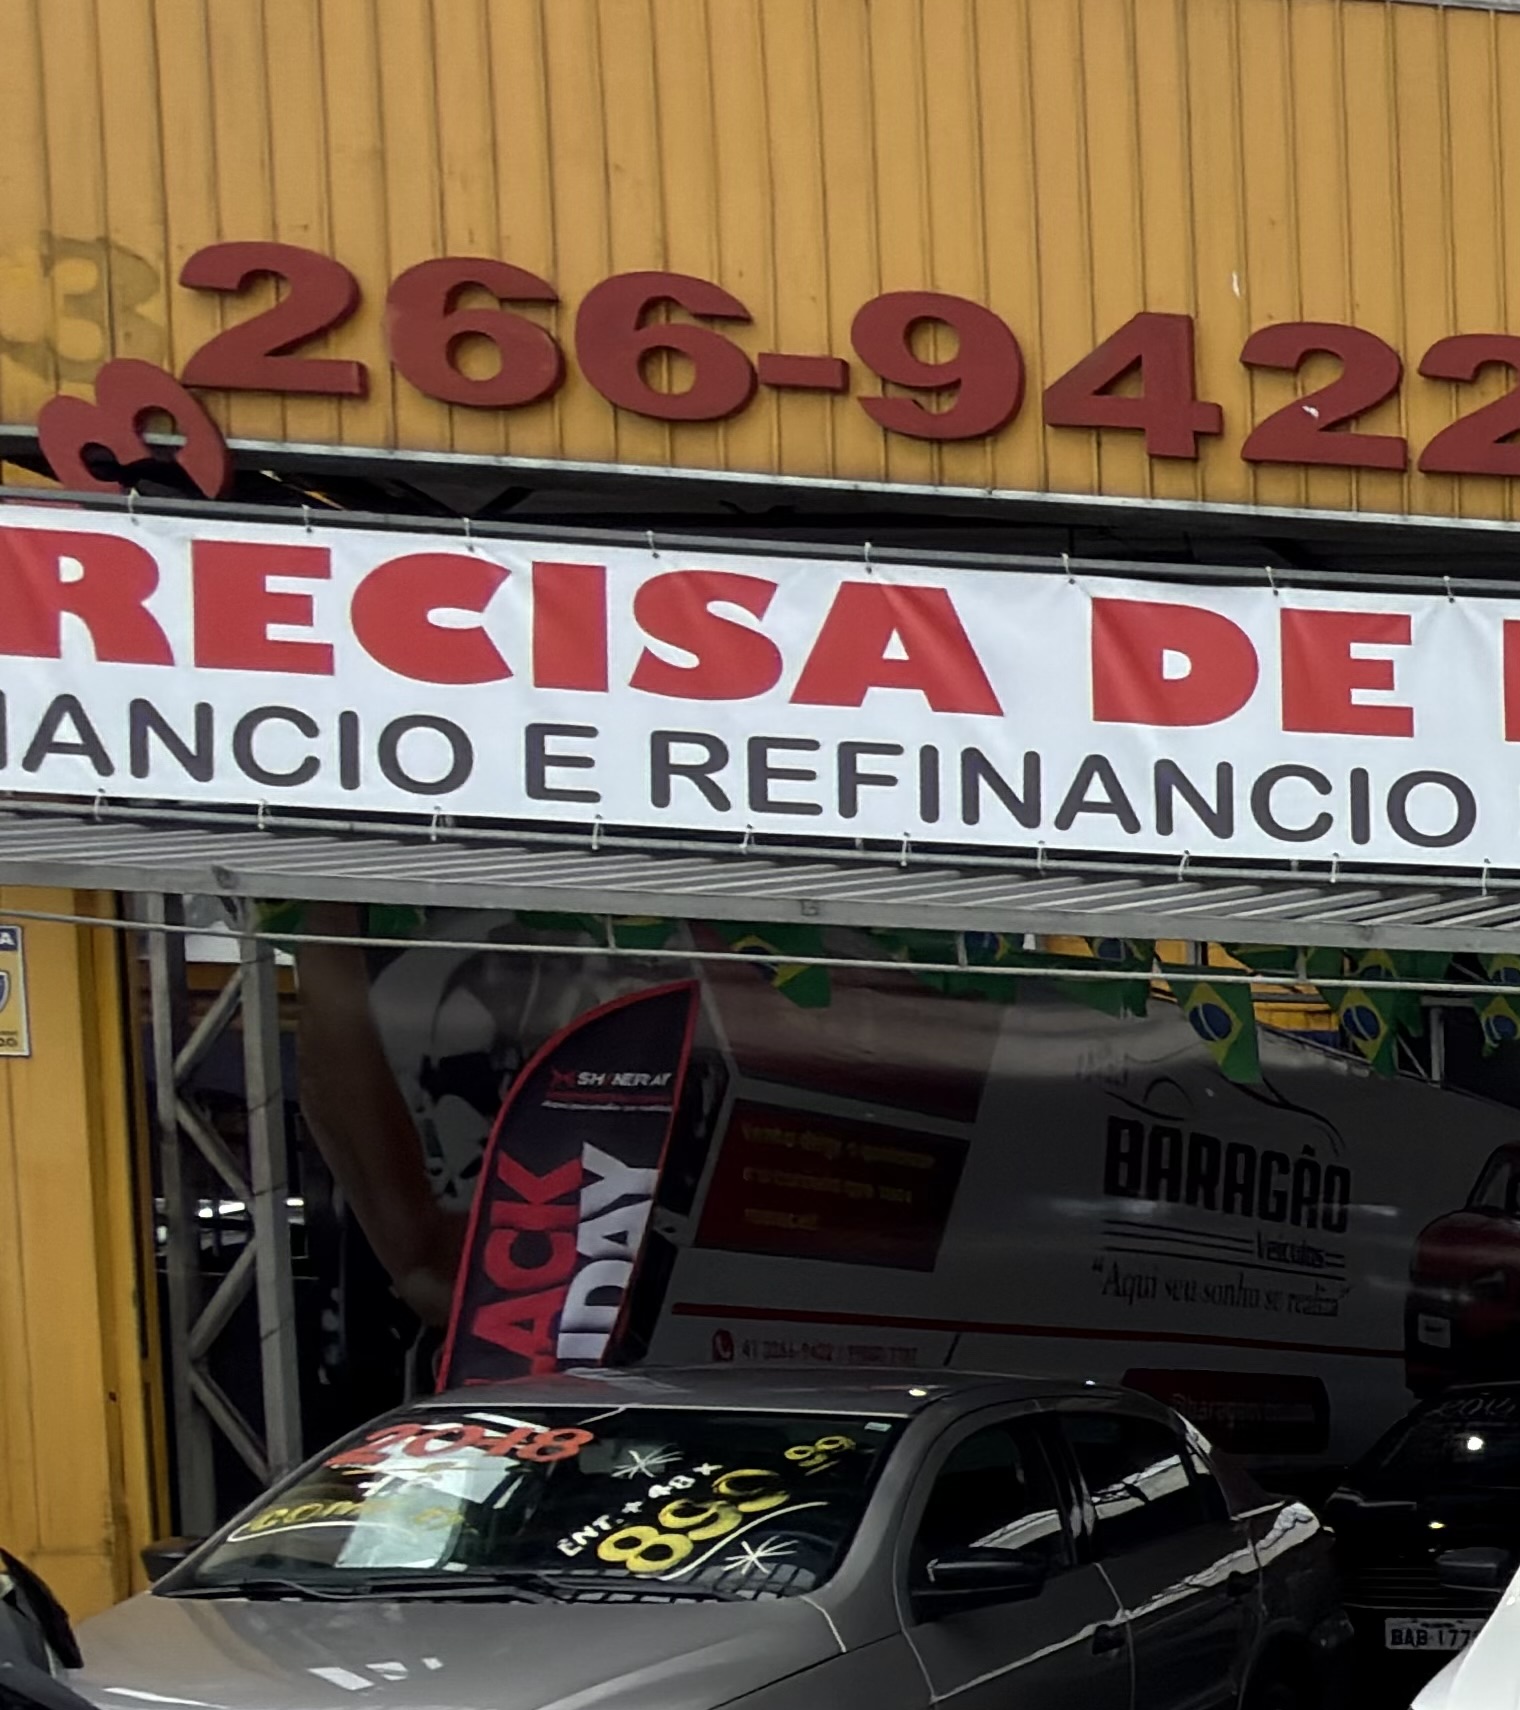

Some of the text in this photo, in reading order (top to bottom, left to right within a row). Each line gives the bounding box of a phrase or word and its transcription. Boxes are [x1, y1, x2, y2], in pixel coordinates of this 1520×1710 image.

[1091, 597, 1414, 739] DE
[0, 689, 475, 796] ANCIO
[524, 723, 603, 804] E
[650, 729, 1477, 848] REFINANCIO
[1102, 1115, 1351, 1234] BARAGÃO
[470, 1150, 585, 1378] ACK
[556, 1142, 662, 1370] IDAY
[324, 1423, 595, 1468] 2018
